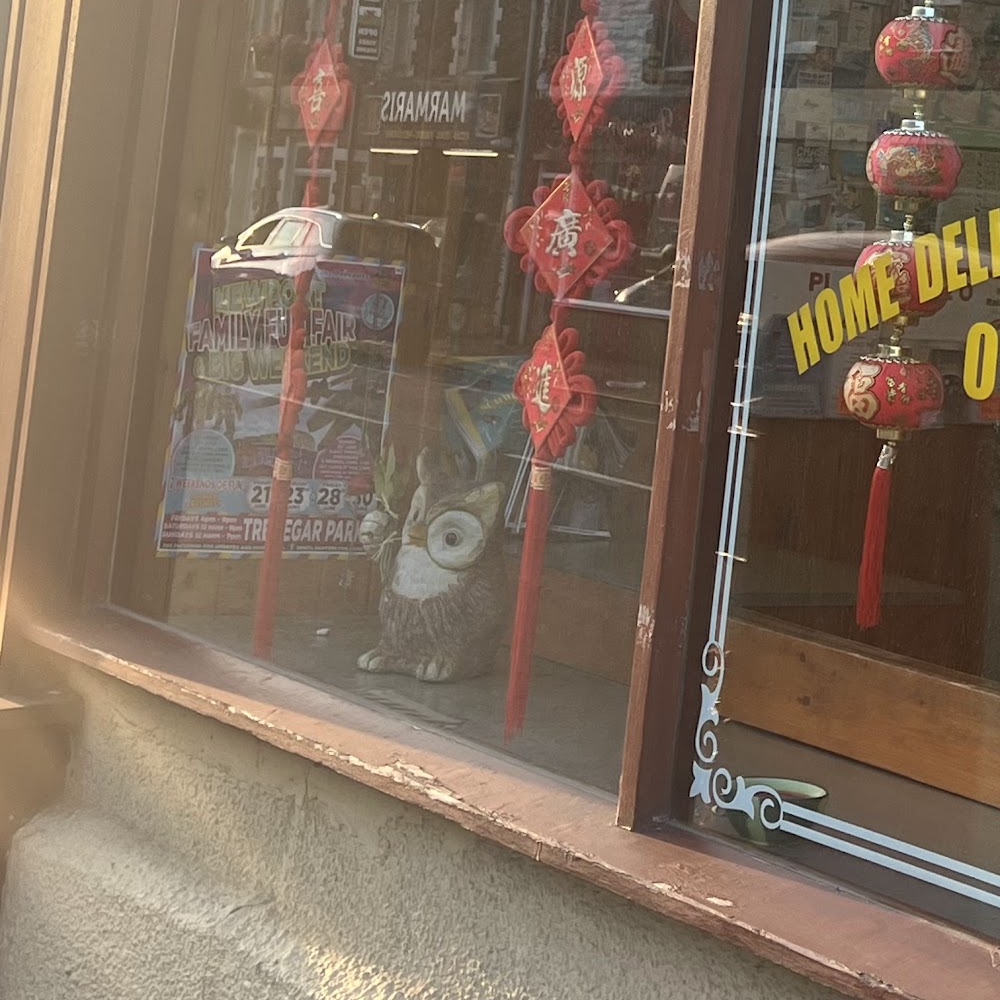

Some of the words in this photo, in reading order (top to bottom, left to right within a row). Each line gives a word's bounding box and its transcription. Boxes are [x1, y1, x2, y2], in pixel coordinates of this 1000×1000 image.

[186, 309, 262, 352] FAMILY
[309, 307, 358, 345] FAIR
[788, 253, 901, 374] HOME
[316, 487, 342, 506] 28
